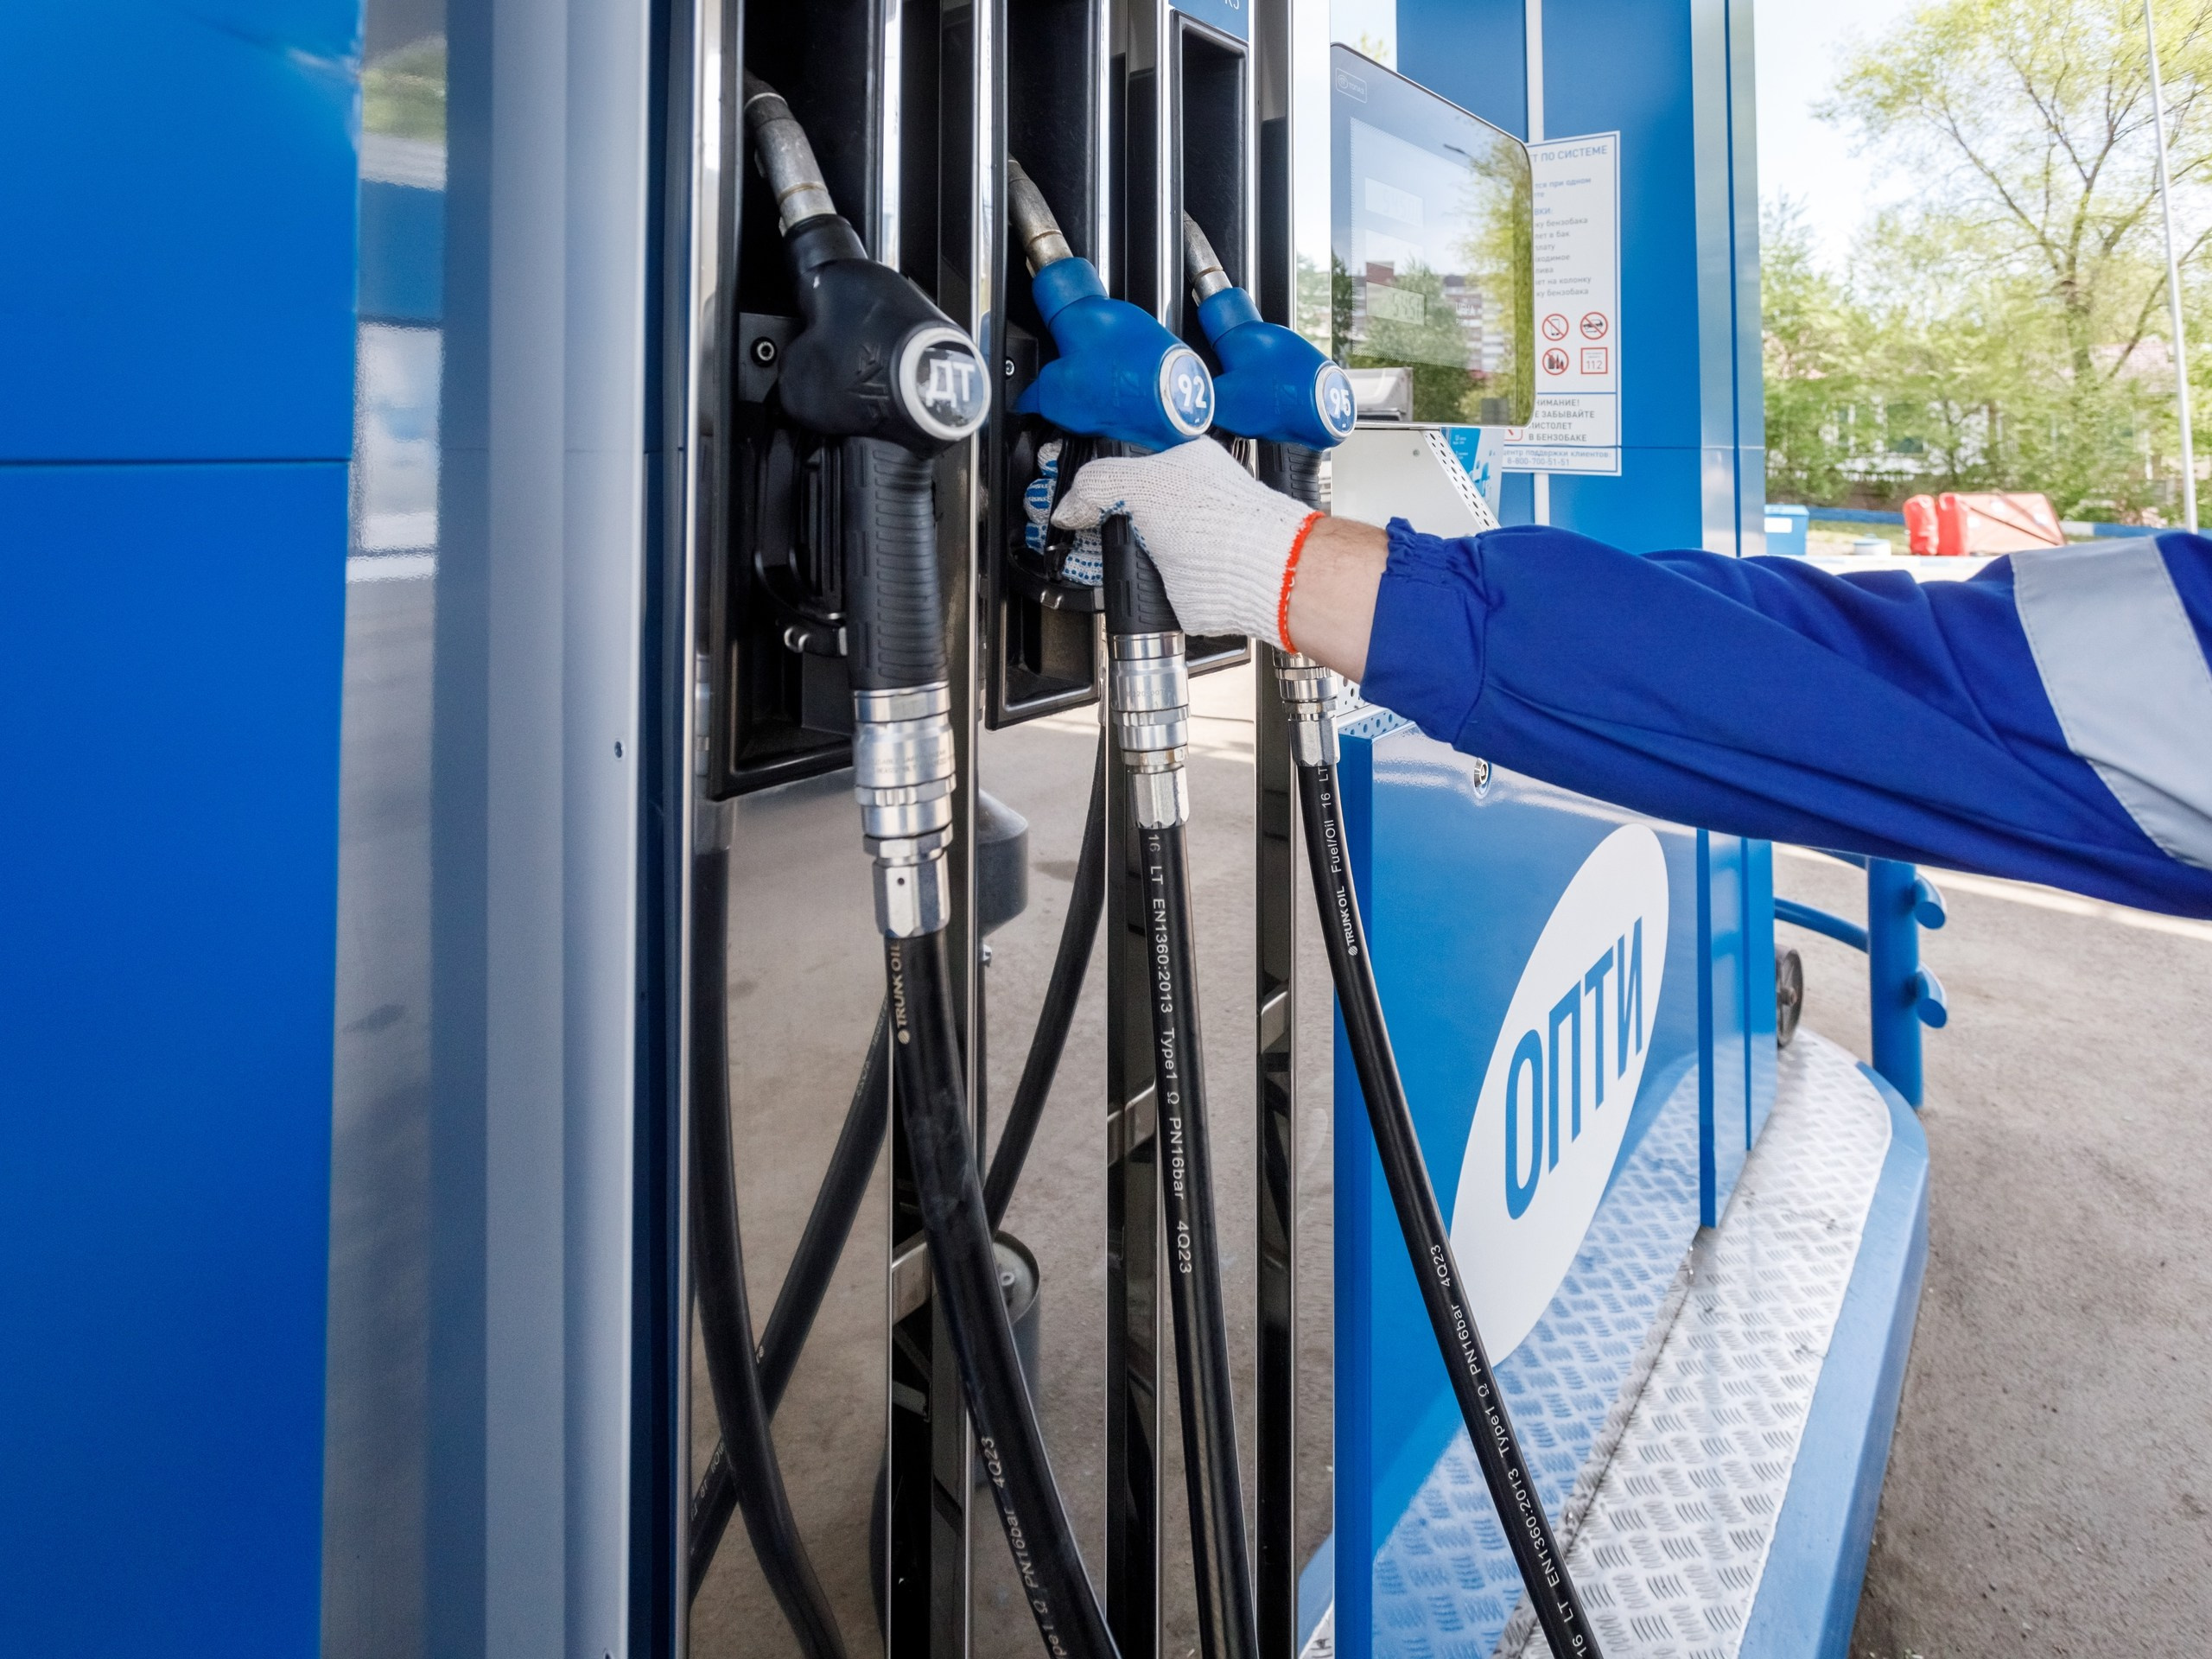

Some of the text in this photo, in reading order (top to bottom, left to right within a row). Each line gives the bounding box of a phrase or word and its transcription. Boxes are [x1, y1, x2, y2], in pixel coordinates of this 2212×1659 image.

[1541, 152, 1555, 162] ПО
[1557, 145, 1608, 160] СИСТЕМЕ
[1546, 217, 1588, 227] бензобака
[1586, 359, 1603, 370] 112
[925, 359, 976, 408] ДТ
[1178, 373, 1207, 409] 92
[1330, 387, 1351, 416] 95
[1541, 409, 1596, 419] ЗАБЫВАЙТЕ
[1525, 449, 1568, 458] поддержки
[1536, 433, 1587, 442] БЕНЗОБАКЕ
[1507, 457, 1570, 467] 8-800-700-51-51
[1148, 834, 1161, 853] 16
[1318, 766, 1355, 946] TRUNK OIL Fuel/Oil 16 LT
[1150, 865, 1163, 885] LT
[1153, 898, 1173, 1014] EN1360:2013
[1160, 1027, 1179, 1080] Type1
[1504, 915, 1643, 1221] ОПТИ
[1169, 1116, 1185, 1200] PN16bar
[1176, 1219, 1192, 1274] 4Q23
[1430, 1243, 1451, 1288] 4Q23
[1451, 1304, 1482, 1376] PN16bar
[1484, 1405, 1510, 1459] Type1
[981, 1436, 1005, 1489] 4Q23
[1508, 1467, 1560, 1588] EN1360:2013
[1004, 1508, 1039, 1589] PN16bar
[1556, 1600, 1574, 1624] LT
[1042, 1624, 1068, 1659] pe1
[1572, 1634, 1587, 1658] 16
